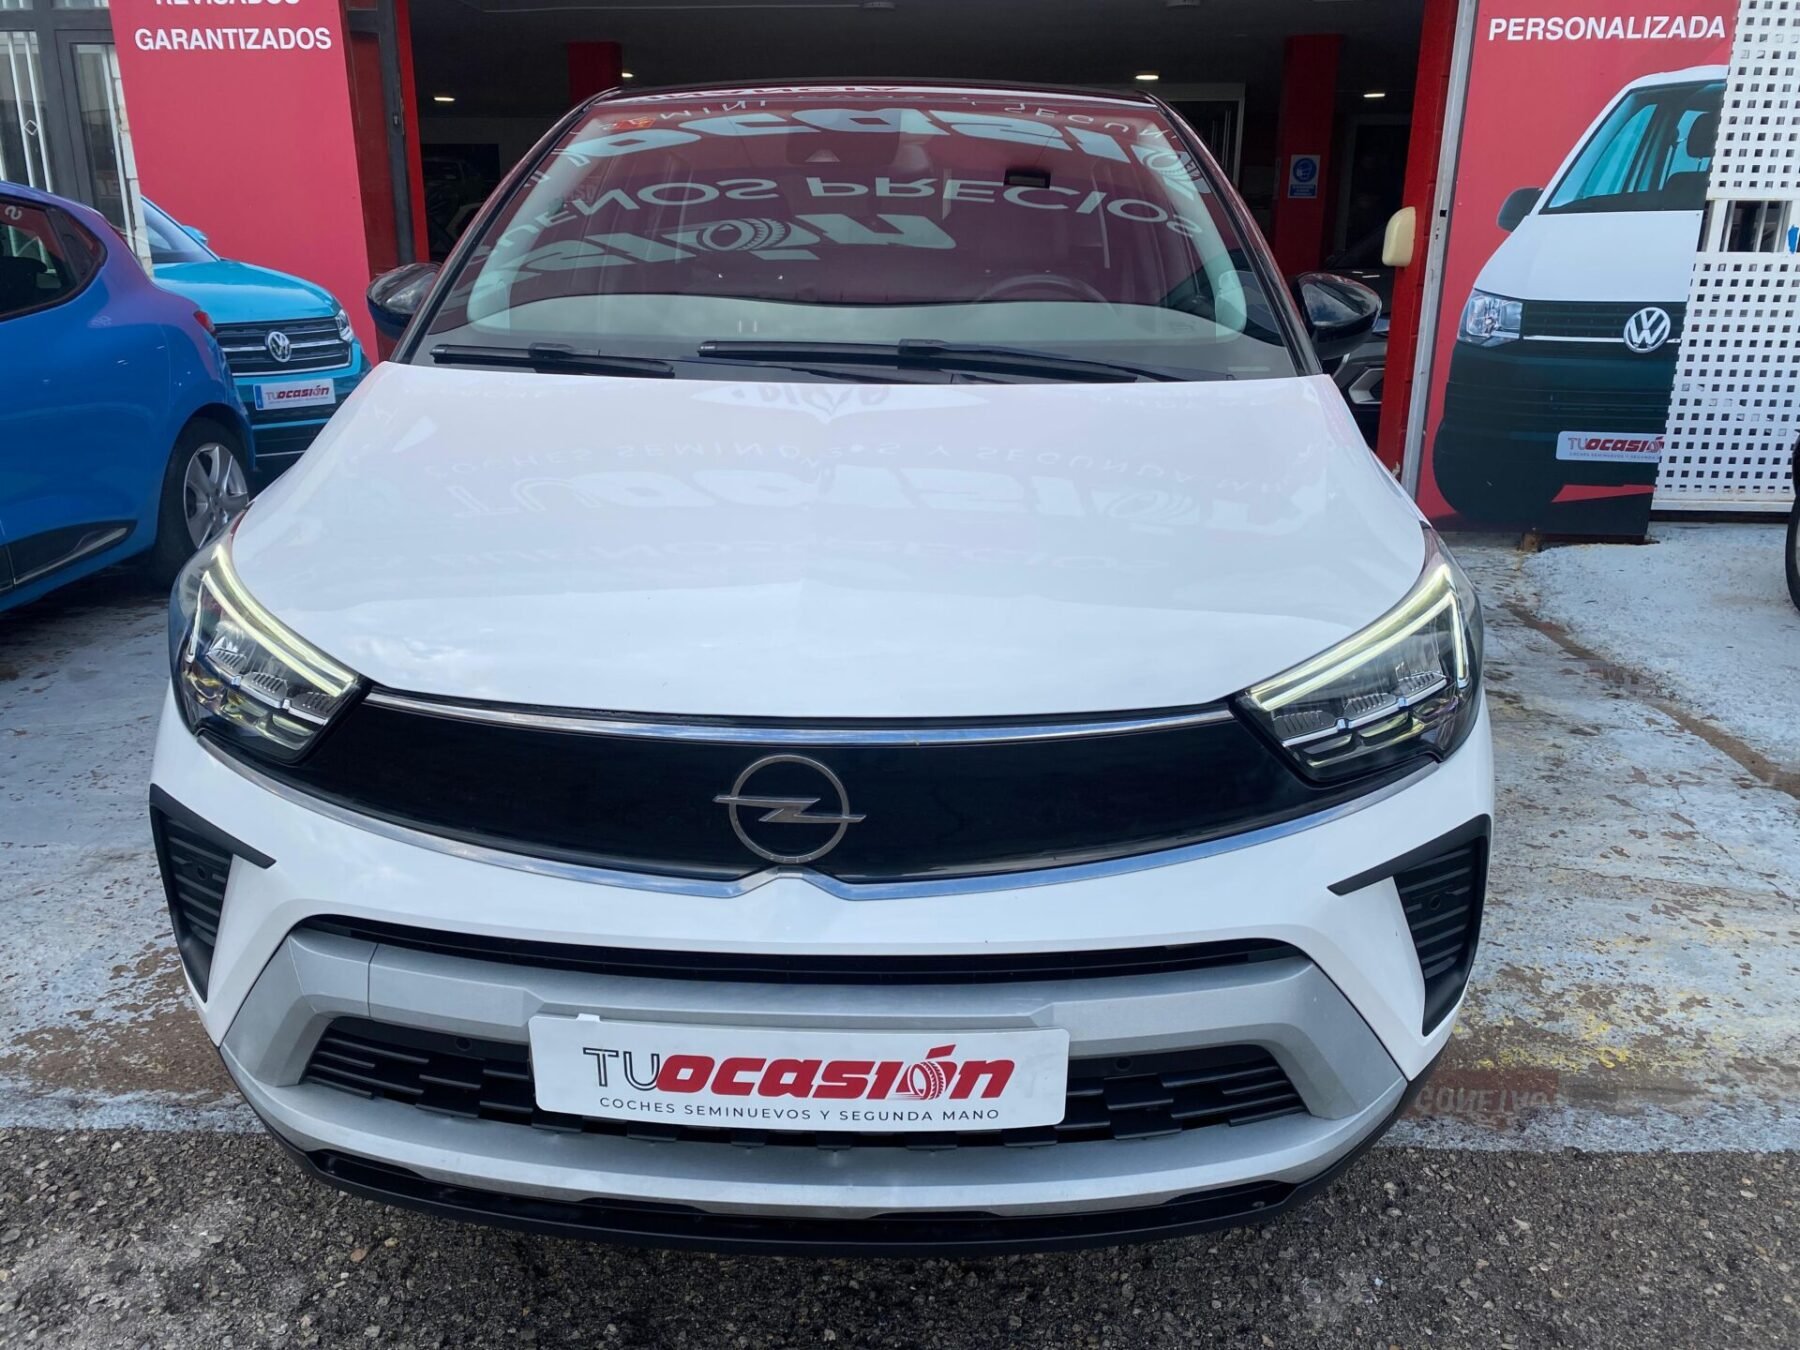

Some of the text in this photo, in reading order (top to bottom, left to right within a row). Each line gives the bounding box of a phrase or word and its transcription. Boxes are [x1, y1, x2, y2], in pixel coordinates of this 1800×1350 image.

[134, 27, 332, 50] GARANTIZADOS
[1488, 15, 1727, 41] PERSONALIZADA
[600, 1097, 999, 1121] COCHES SEMINUEVOS Y SEGUNDA MANO
